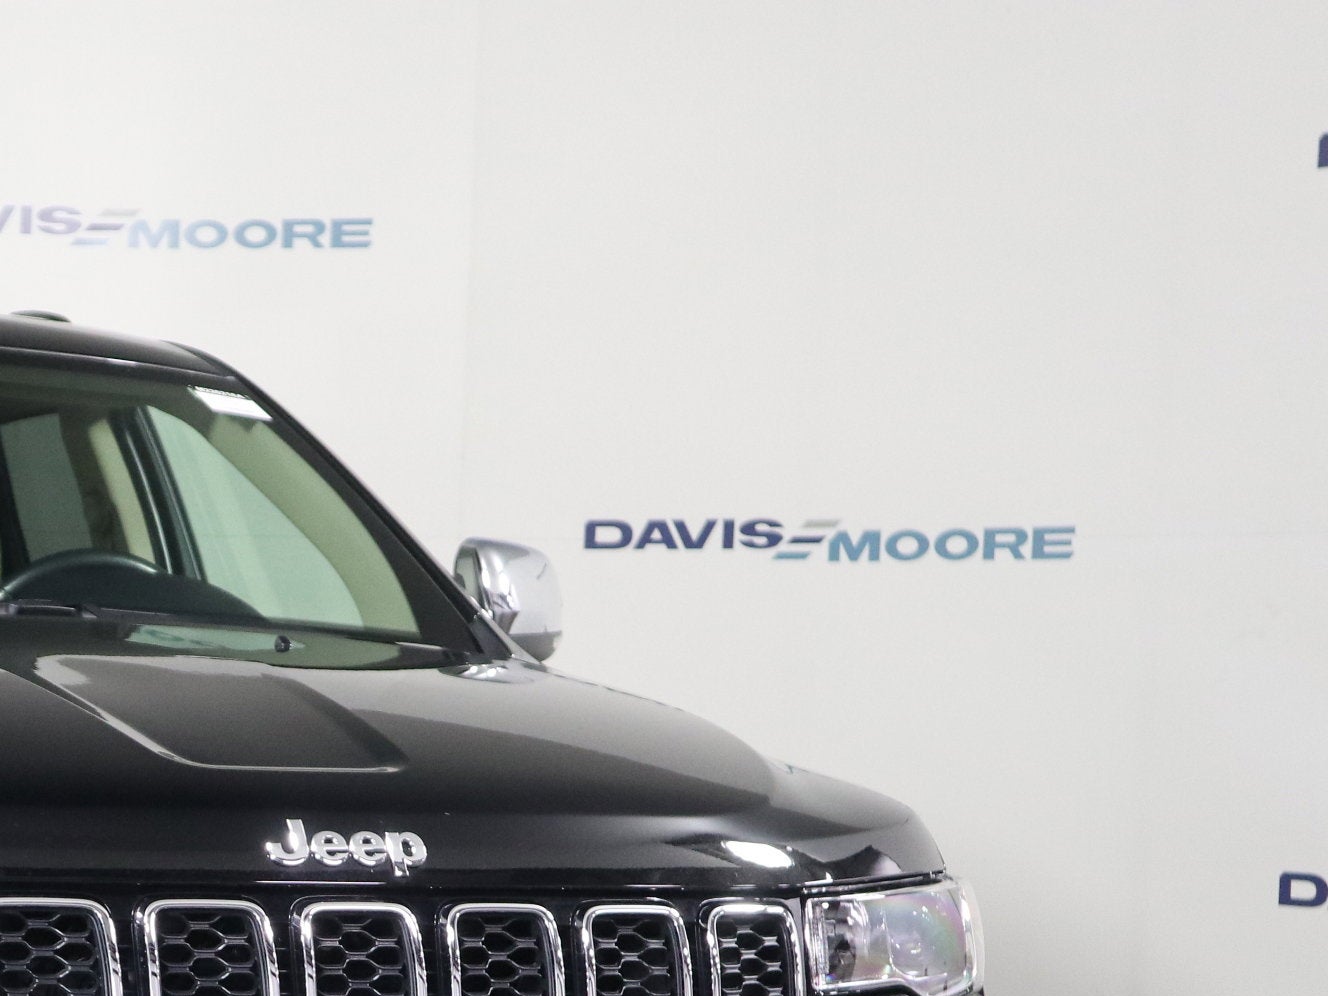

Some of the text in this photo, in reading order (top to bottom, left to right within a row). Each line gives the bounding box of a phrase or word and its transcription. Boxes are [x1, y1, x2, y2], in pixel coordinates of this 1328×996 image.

[127, 217, 375, 250] MOORE
[583, 519, 1076, 562] DAVIS MOORE
[265, 818, 428, 877] Jeep
